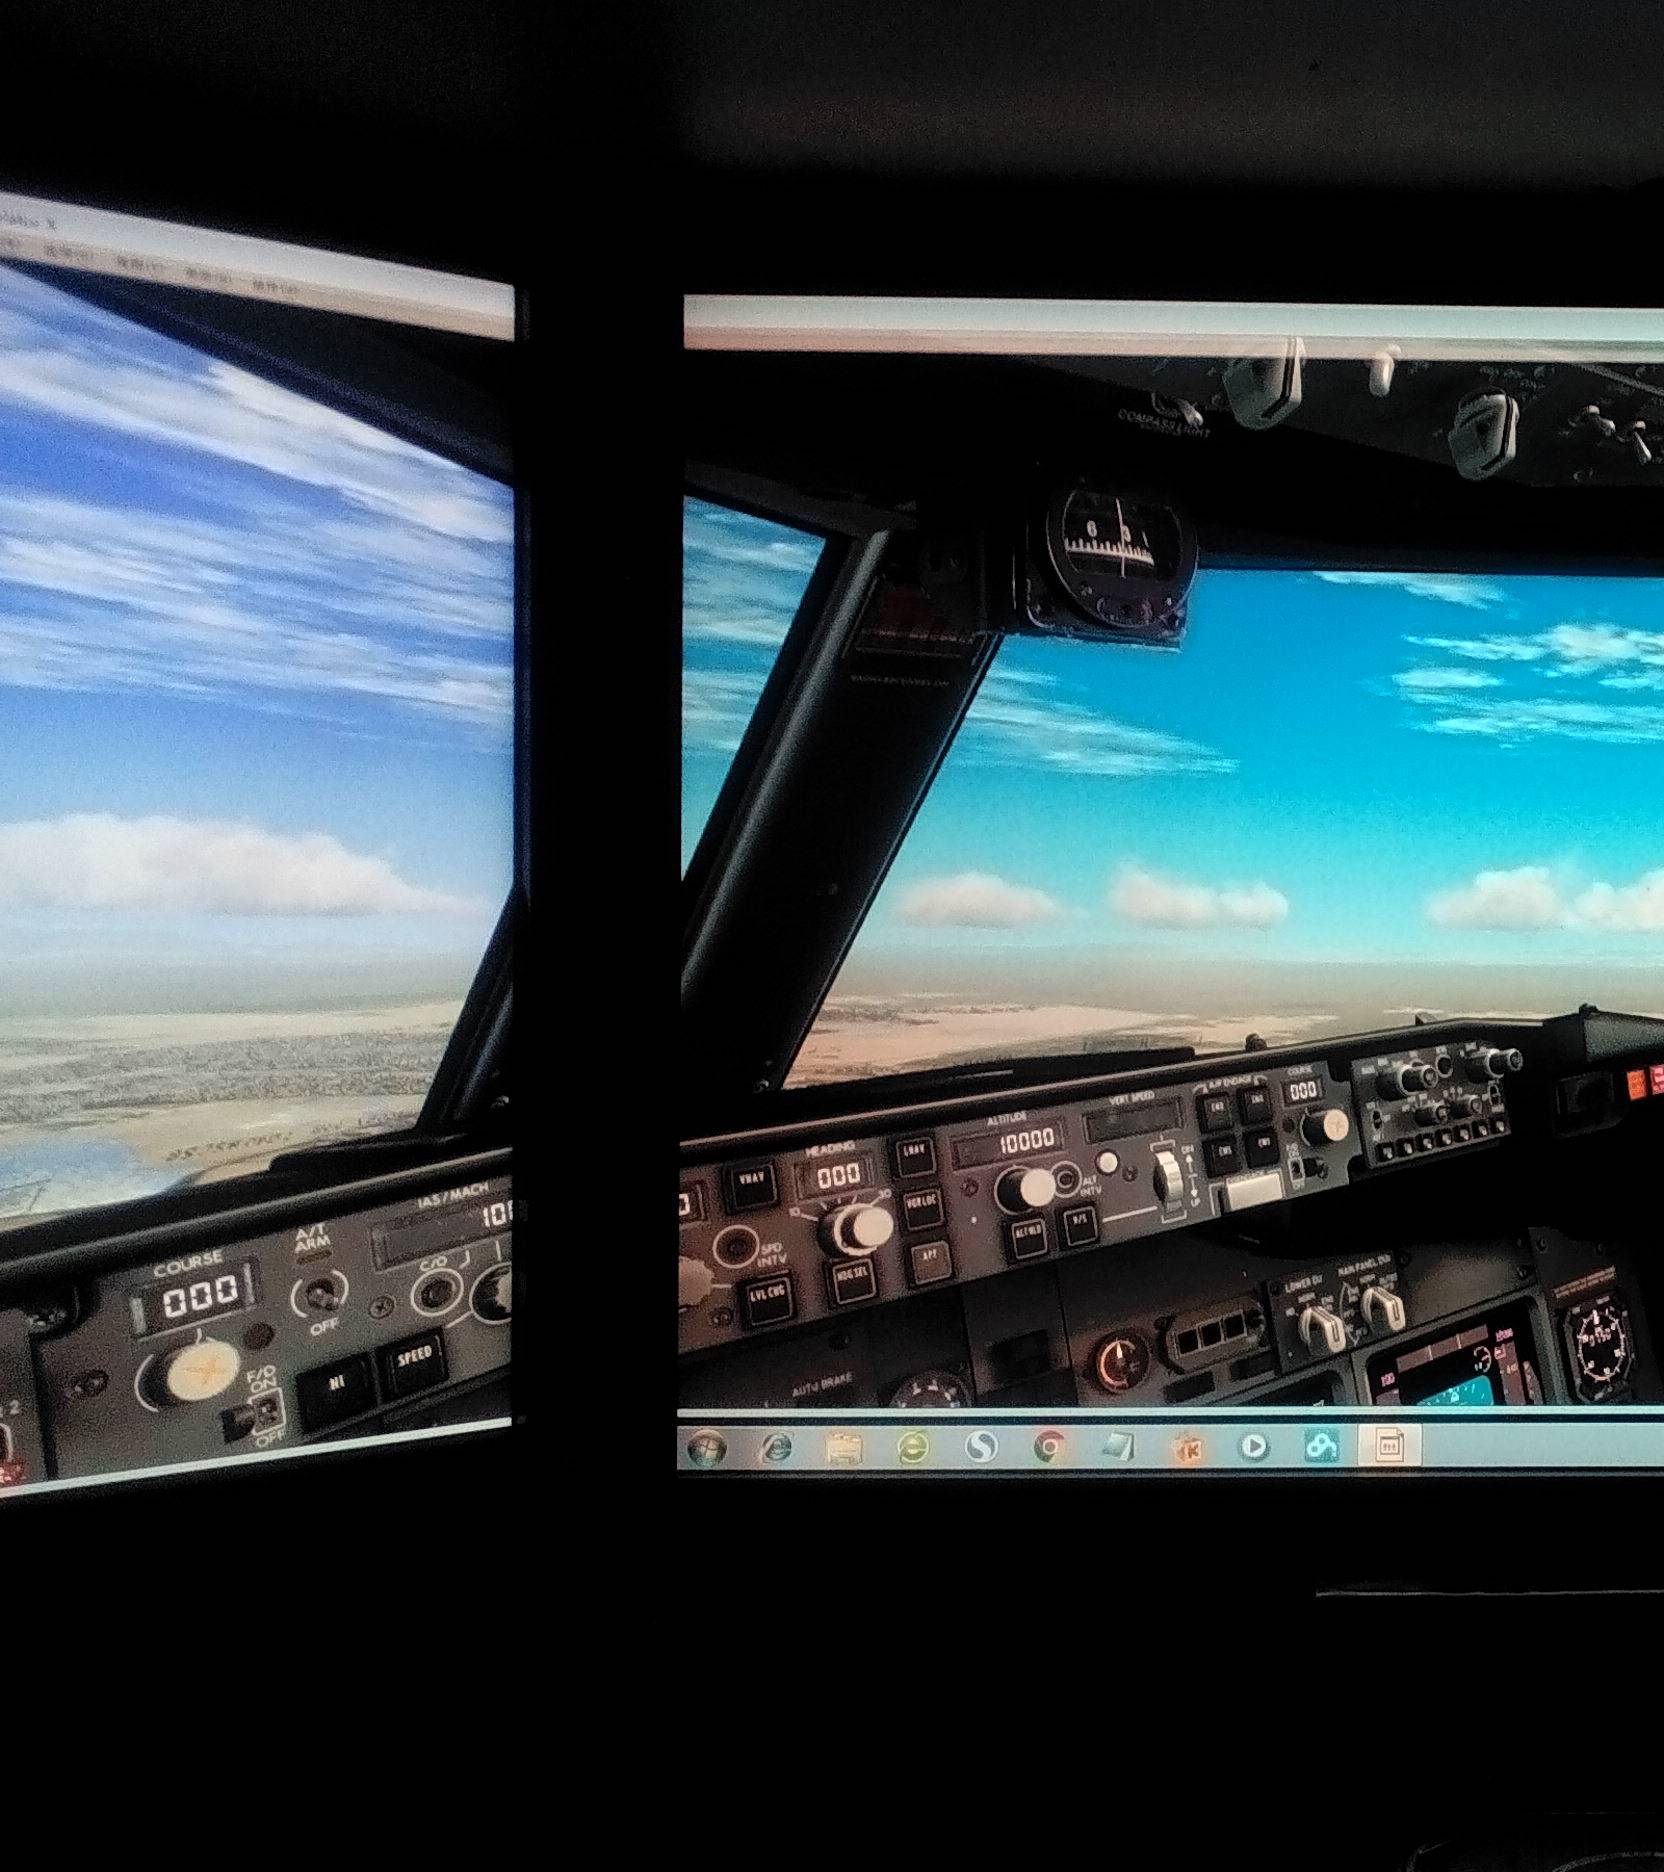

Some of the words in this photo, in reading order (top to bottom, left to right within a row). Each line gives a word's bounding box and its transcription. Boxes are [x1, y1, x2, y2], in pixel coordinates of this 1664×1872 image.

[1290, 1081, 1317, 1101] 000
[987, 1111, 1028, 1126] ALTITUDE
[1000, 1127, 1055, 1154] 10000
[817, 1162, 861, 1190] 000
[417, 1182, 490, 1209] IAS/MACH
[296, 1223, 326, 1240] A/T
[295, 1233, 331, 1253] ARM
[153, 1250, 224, 1278] COURSE
[420, 1256, 448, 1272] C/O
[757, 1254, 788, 1268] INTV
[163, 1274, 239, 1319] 000
[310, 1318, 341, 1336] OFF
[397, 1345, 433, 1367] SPEED
[251, 1376, 277, 1393] ON
[821, 1371, 853, 1391] BRAKE
[9, 1399, 20, 1415] 2
[256, 1428, 285, 1447] OFF
